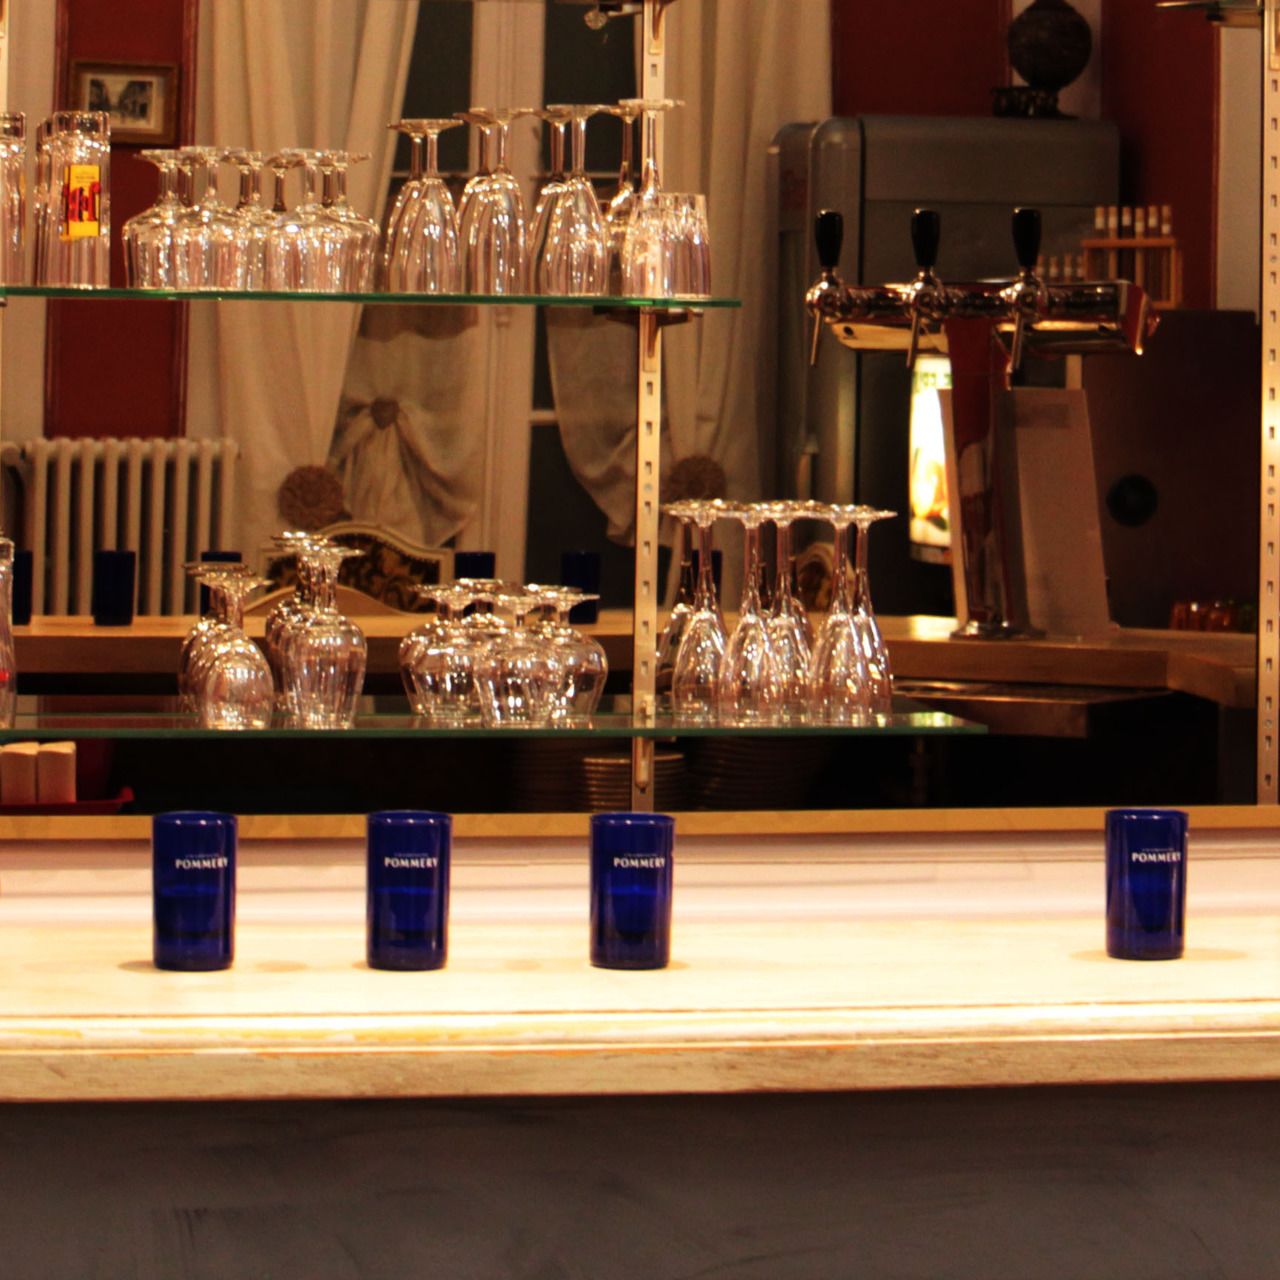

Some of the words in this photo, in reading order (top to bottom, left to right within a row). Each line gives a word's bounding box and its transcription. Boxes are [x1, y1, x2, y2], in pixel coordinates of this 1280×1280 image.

[175, 857, 228, 869] POMMERY
[384, 856, 439, 868] POMMERY
[613, 856, 666, 868] POMMERY
[1131, 851, 1181, 863] POMMERY
